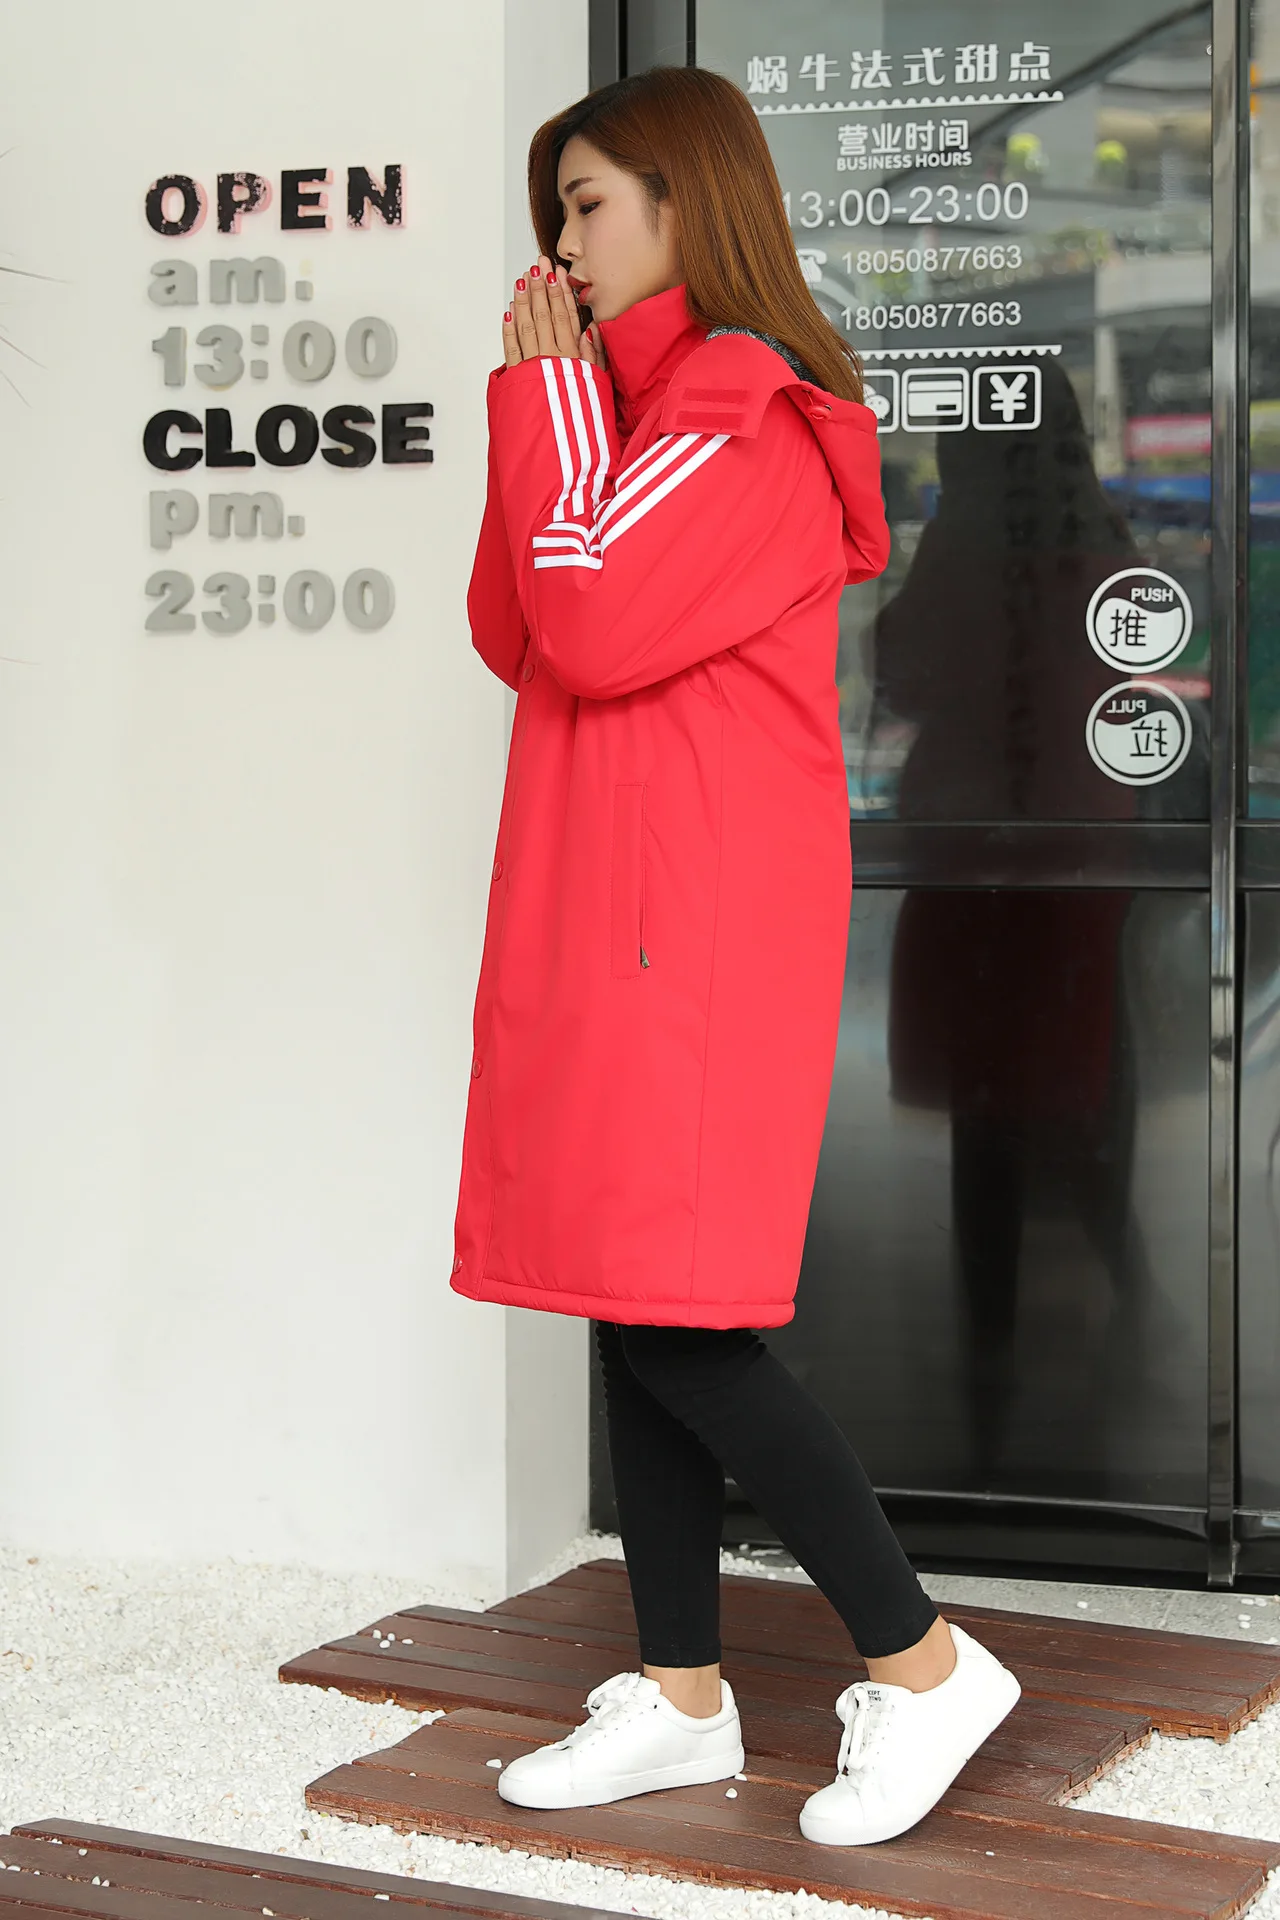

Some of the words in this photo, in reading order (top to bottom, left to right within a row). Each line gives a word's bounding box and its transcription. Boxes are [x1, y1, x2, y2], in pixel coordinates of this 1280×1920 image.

[747, 42, 1051, 94] 蜗牛法式甜点
[837, 119, 969, 156] 营业时间
[837, 154, 912, 171] BUSINESS
[915, 151, 972, 168] HOURS
[145, 164, 406, 236] OPEN
[782, 182, 1029, 228] 13:00-23:00
[147, 256, 313, 306] am.
[841, 245, 1022, 274] 18050877663
[841, 301, 1022, 330] 18050877663
[152, 316, 398, 387] 13:00
[143, 403, 434, 471] CLOSE
[149, 488, 305, 549] pm.
[144, 568, 395, 633] 23:00
[1130, 588, 1174, 602] PUSH
[1110, 608, 1147, 647] 推
